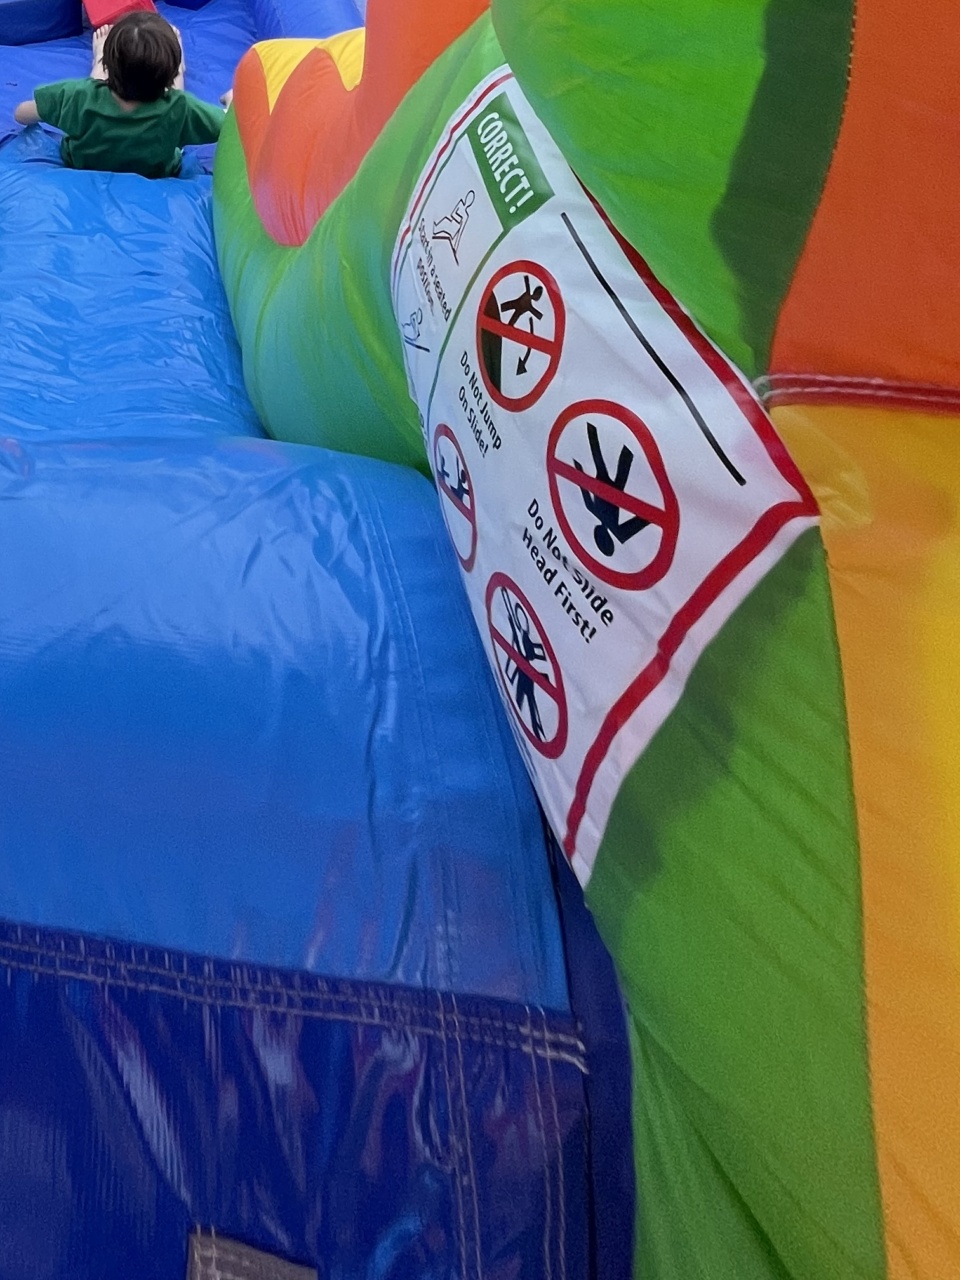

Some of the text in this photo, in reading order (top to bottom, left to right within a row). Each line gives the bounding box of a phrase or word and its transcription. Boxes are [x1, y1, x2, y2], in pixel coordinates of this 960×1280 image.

[477, 111, 535, 214] CORRECT!
[433, 274, 452, 323] seated
[458, 385, 489, 459] On Slide!
[460, 350, 502, 450] Do Not Jump
[522, 527, 597, 644] Head First!
[527, 498, 544, 531] Do
[571, 567, 614, 628] Slide
